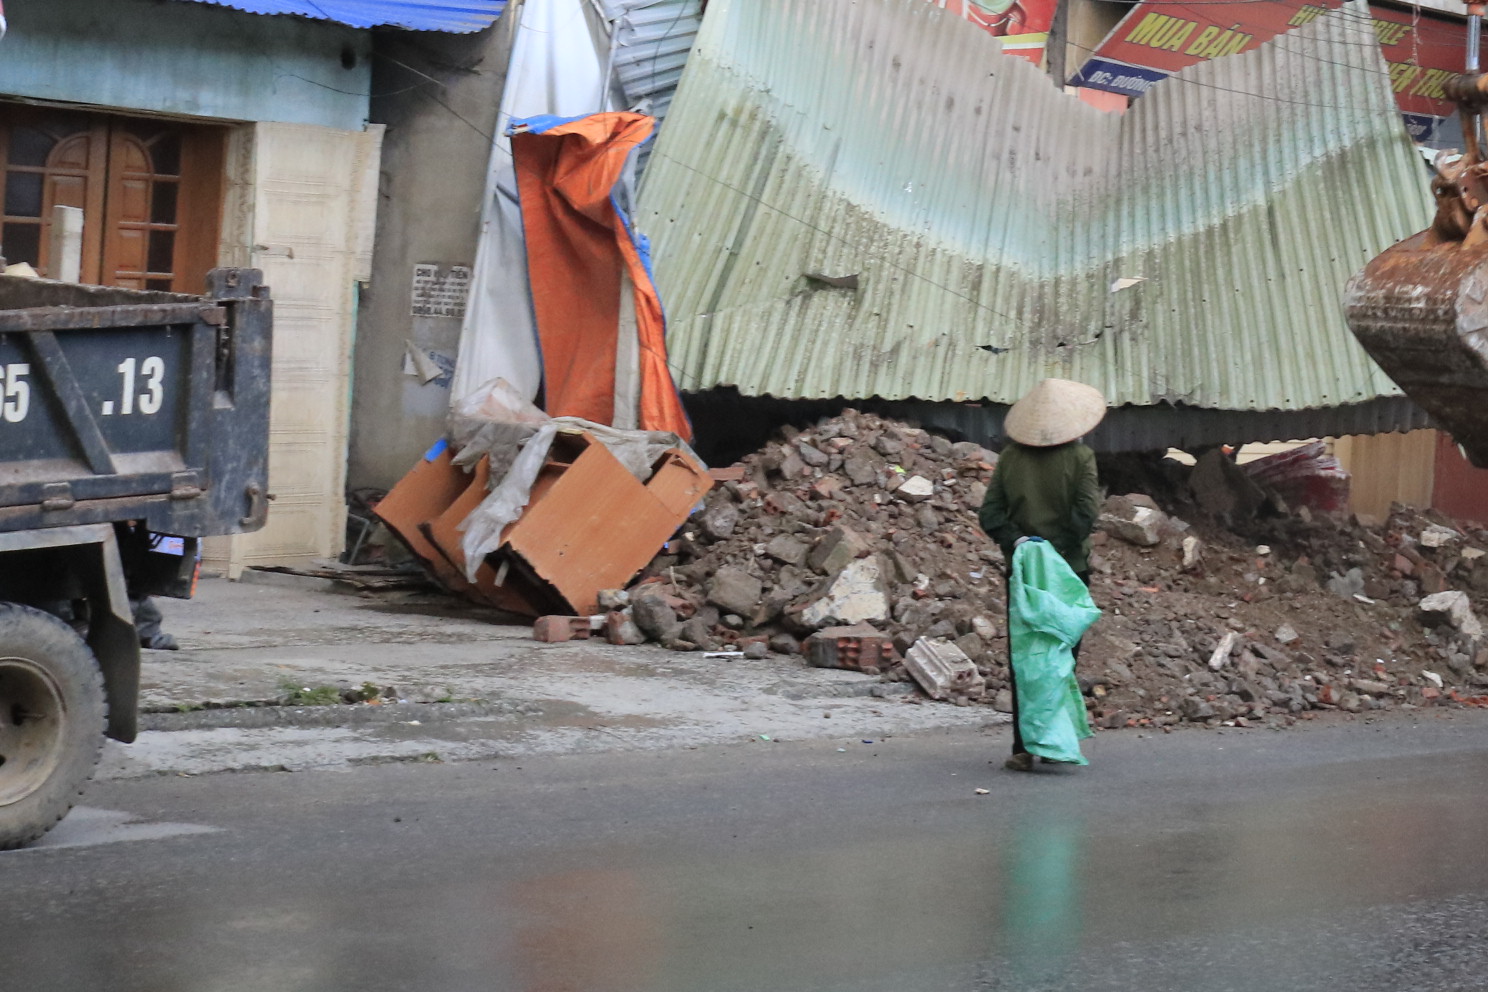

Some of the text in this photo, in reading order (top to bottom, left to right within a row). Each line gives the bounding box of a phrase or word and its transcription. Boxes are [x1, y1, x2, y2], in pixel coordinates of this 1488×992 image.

[1125, 12, 1254, 59] MUA BÁN
[0, 363, 31, 423] 5
